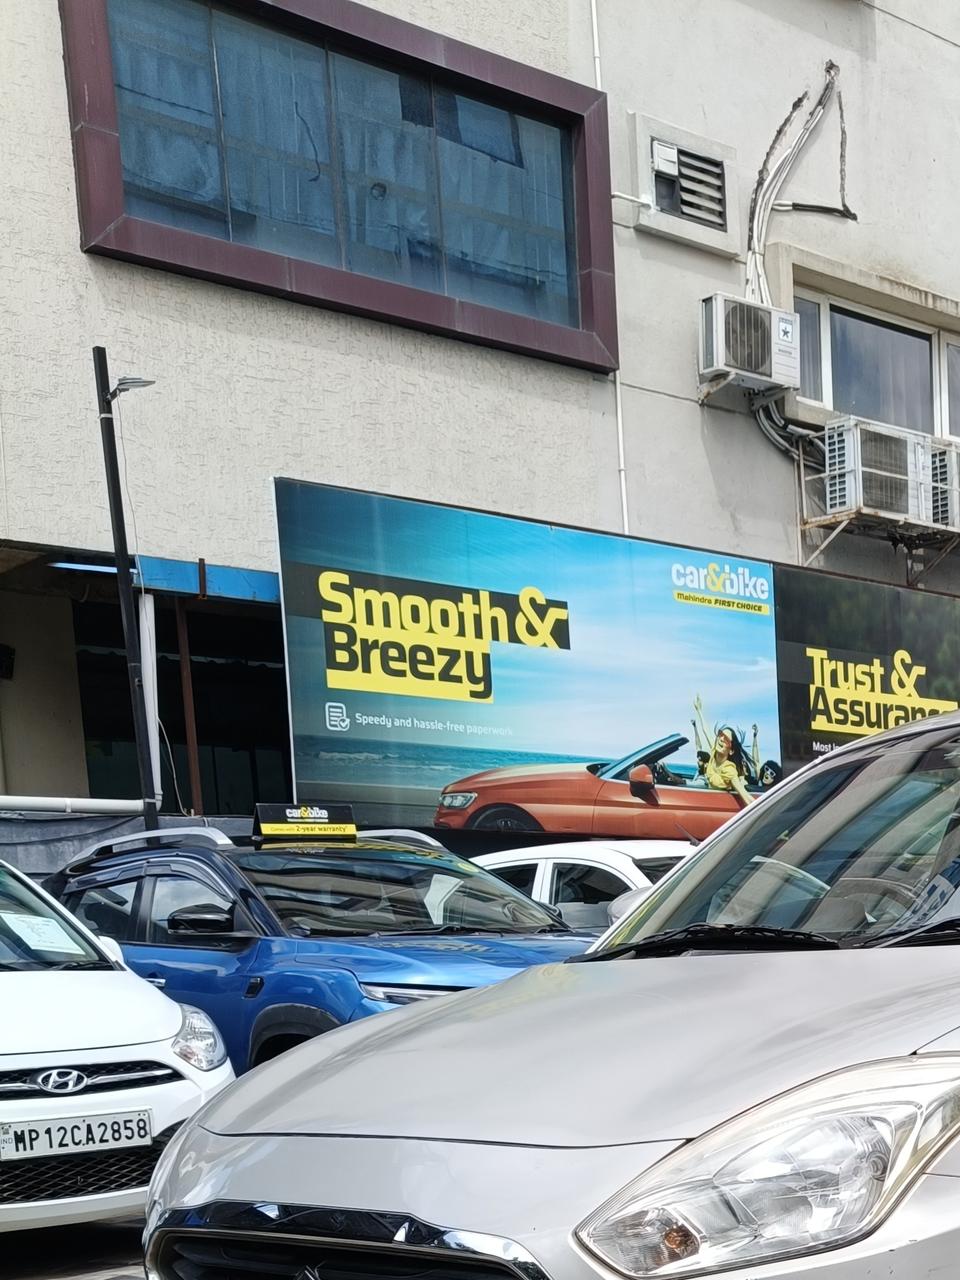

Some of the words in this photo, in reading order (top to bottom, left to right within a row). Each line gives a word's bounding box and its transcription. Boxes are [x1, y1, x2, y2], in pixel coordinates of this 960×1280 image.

[671, 562, 769, 600] car&bike
[318, 571, 509, 643] Smooth
[515, 586, 570, 649] &
[677, 592, 712, 605] Mahindra
[714, 599, 735, 608] FIRST
[736, 602, 762, 612] CHOICE
[323, 621, 492, 700] Breezy
[806, 647, 884, 695] Trust
[891, 649, 926, 699] &
[355, 713, 392, 728] Speedy
[394, 717, 412, 728] and
[414, 718, 465, 732] hassle-free
[467, 724, 513, 737] paperwork
[811, 686, 952, 729] Assuran
[812, 741, 832, 752] Most
[286, 807, 328, 818] car&bike
[13, 1118, 148, 1152] MP12CA2858
